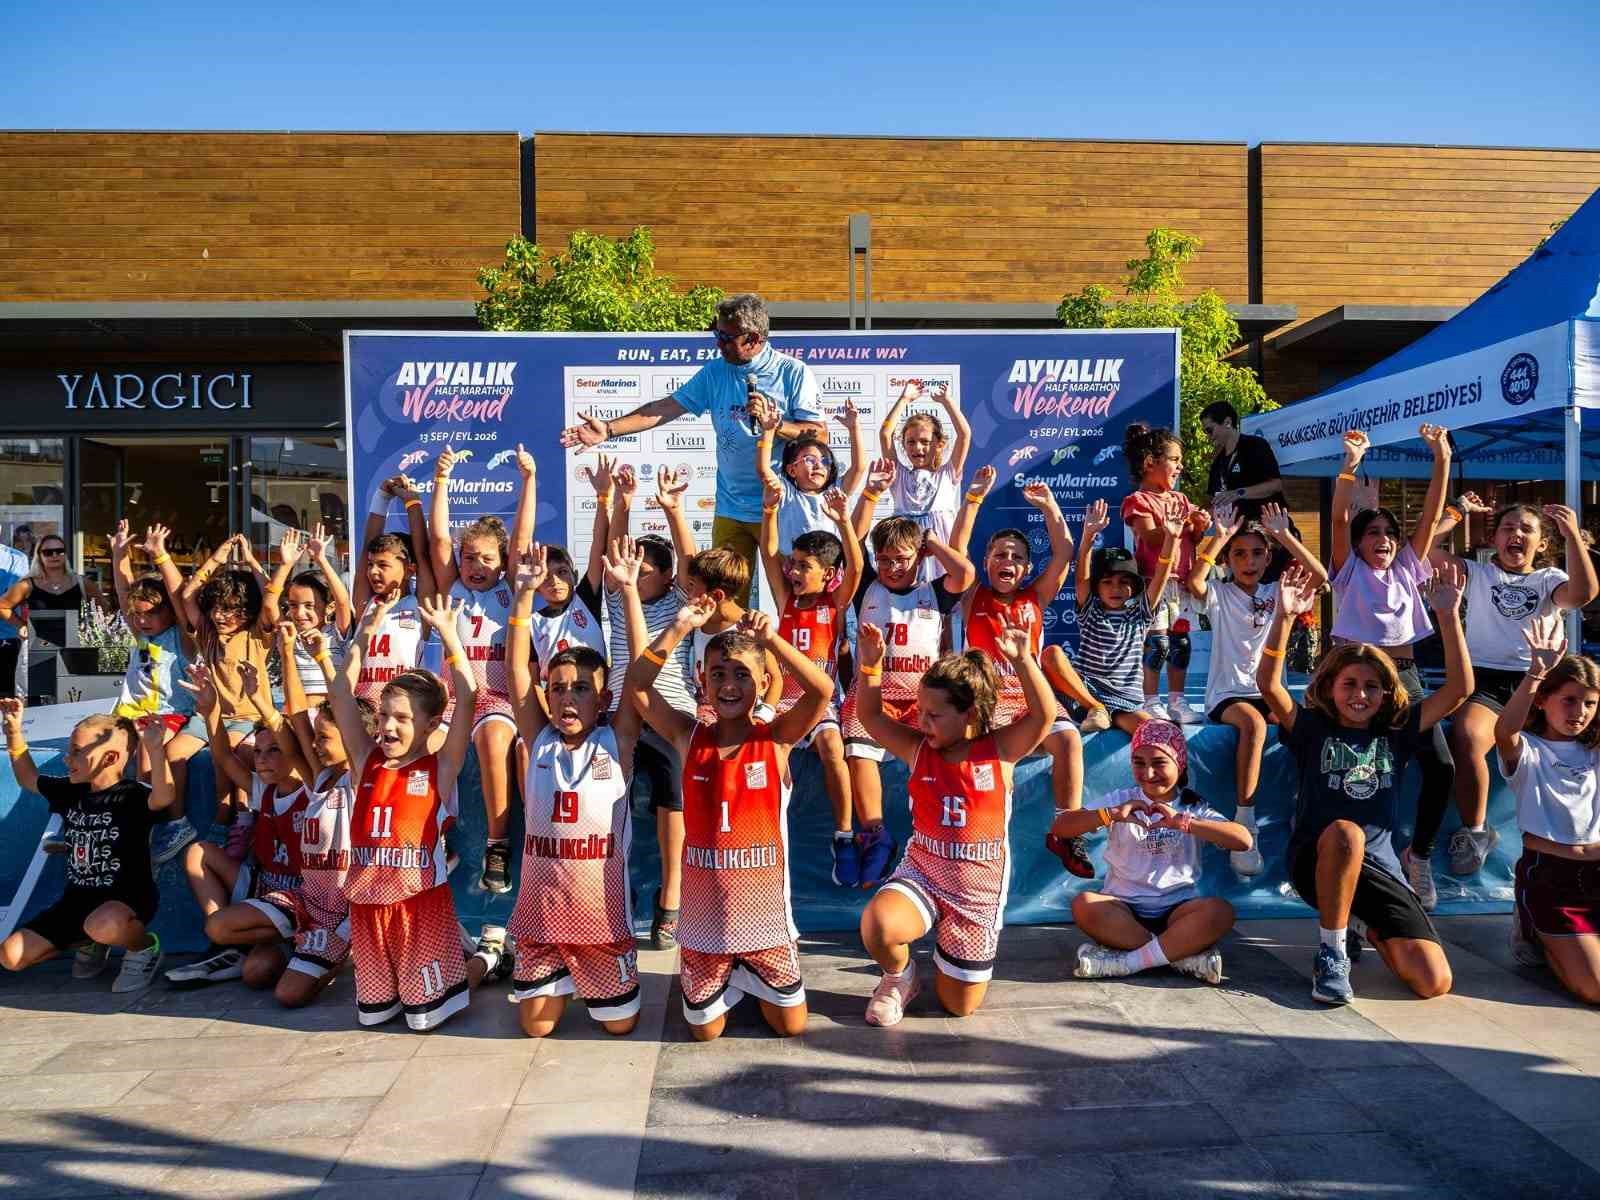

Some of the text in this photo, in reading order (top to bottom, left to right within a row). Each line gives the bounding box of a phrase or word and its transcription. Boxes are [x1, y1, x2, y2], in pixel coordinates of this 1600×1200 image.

[618, 349, 655, 362] RUN,
[660, 349, 692, 362] EAT,
[808, 348, 871, 360] AYVALIK
[876, 348, 908, 359] WAY
[396, 361, 517, 386] AYVALIK
[1008, 359, 1125, 383] AYVALIK
[1510, 368, 1527, 380] 444
[57, 372, 252, 409] YARGICI
[434, 386, 513, 396] HALF MARATHON
[577, 379, 637, 387] SeturMarinas
[823, 377, 861, 390] divan
[1045, 383, 1120, 392] HALF MARATHON
[403, 377, 511, 423] Weekend
[1014, 373, 1117, 419] Weekend
[1403, 376, 1482, 418] BELEDİYESİ
[420, 434, 428, 443] 13
[431, 432, 449, 441] SEP
[455, 432, 473, 441] EYL
[474, 432, 497, 441] 2026
[666, 432, 705, 446] divan
[1029, 429, 1039, 438] 13
[1040, 428, 1057, 437] SEP
[1064, 428, 1081, 436] EYL
[1081, 428, 1104, 436] 2026
[1012, 449, 1033, 460] 21K
[1053, 448, 1076, 460] 10K
[1099, 449, 1115, 459] 5K
[408, 478, 513, 493] SetMarinas
[1054, 490, 1085, 499] YVALIK
[447, 497, 478, 505] YVALIK
[471, 615, 484, 638] 7
[885, 623, 908, 646] 78
[368, 634, 391, 657] 14
[791, 628, 811, 650] 19
[551, 790, 579, 824] 19
[941, 796, 967, 828] 15
[370, 806, 393, 838] 11
[720, 801, 732, 833] 1
[304, 817, 320, 845] 10
[420, 960, 444, 996] 11
